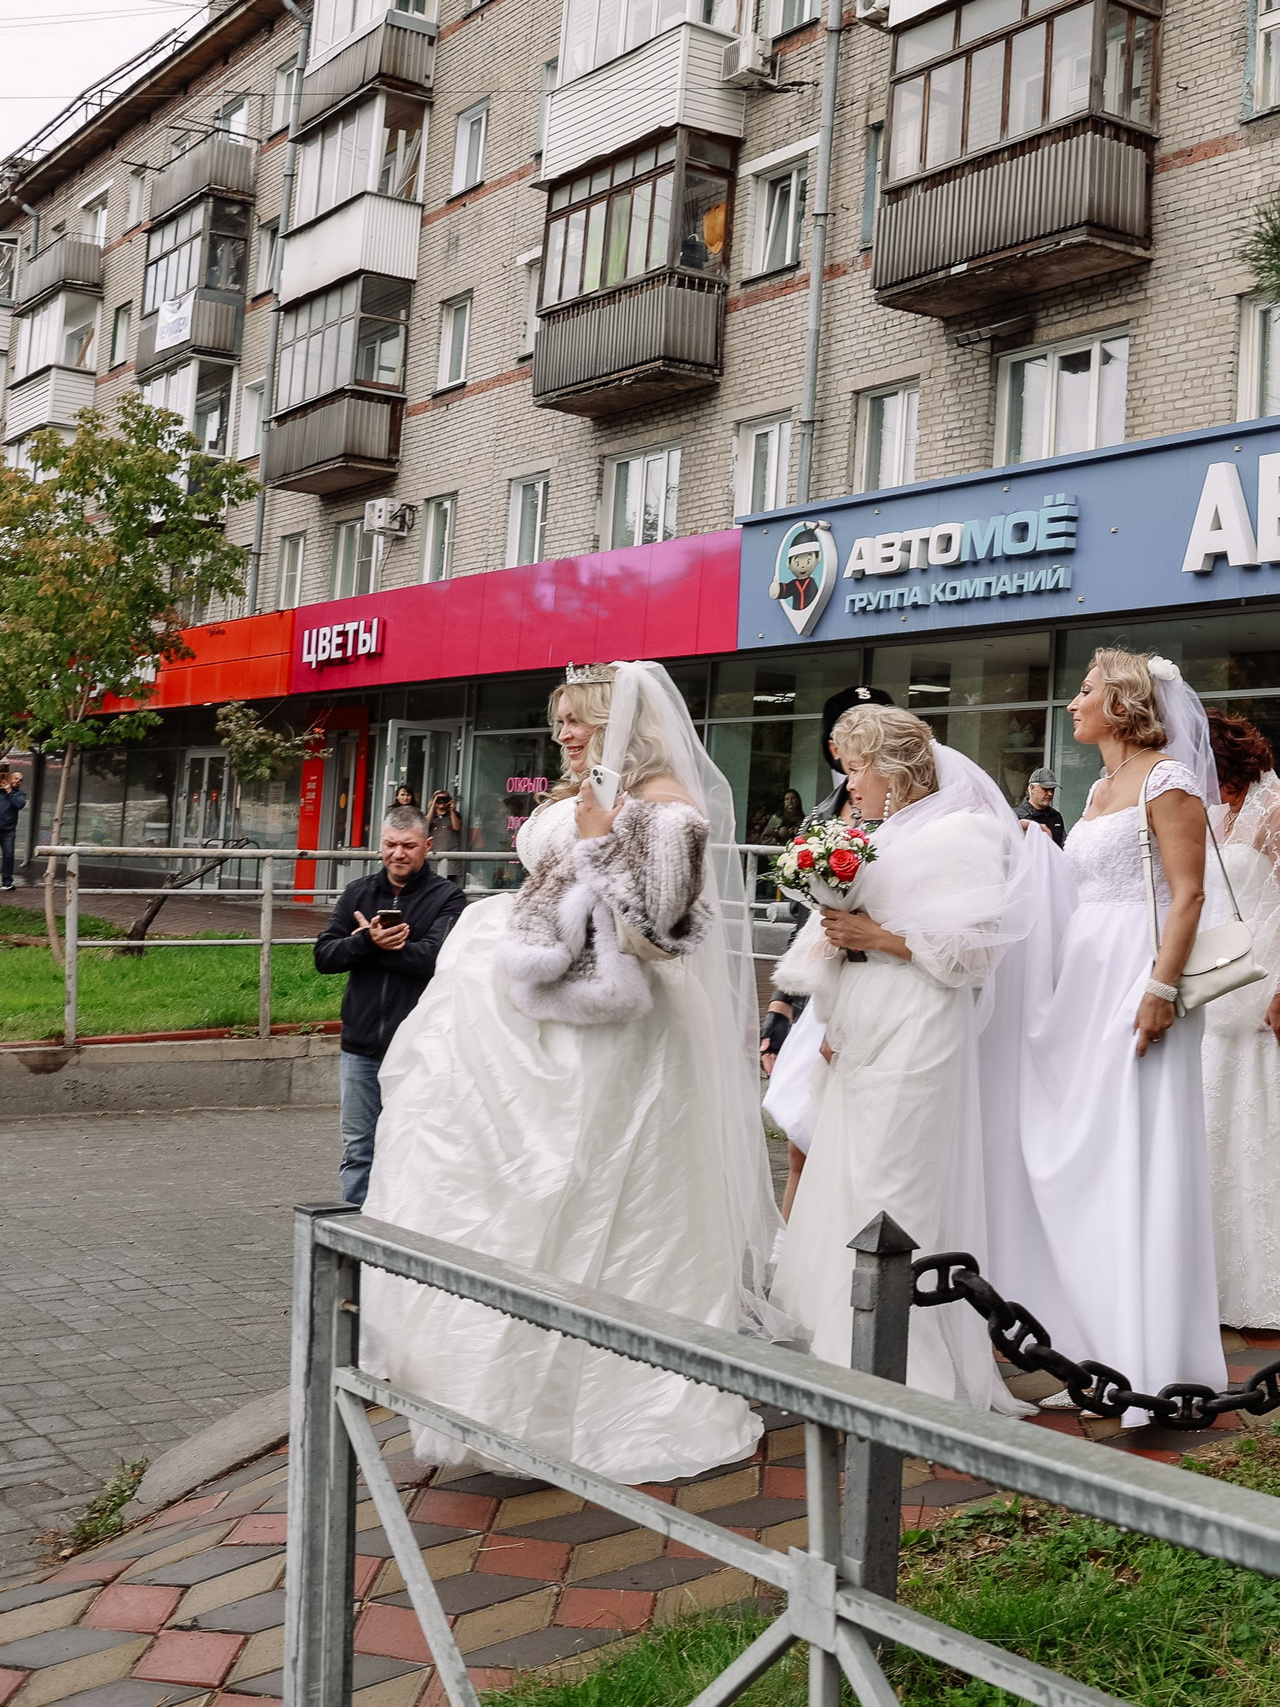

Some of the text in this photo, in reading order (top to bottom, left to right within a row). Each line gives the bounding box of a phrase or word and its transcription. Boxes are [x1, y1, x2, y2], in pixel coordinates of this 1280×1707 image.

[843, 493, 1079, 579] АВТОМОЁ
[845, 565, 1072, 614] ГРУППА КОМПАНИЙ
[302, 617, 380, 669] ЦВЕТЫ
[506, 777, 549, 793] ОТКРЫТО
